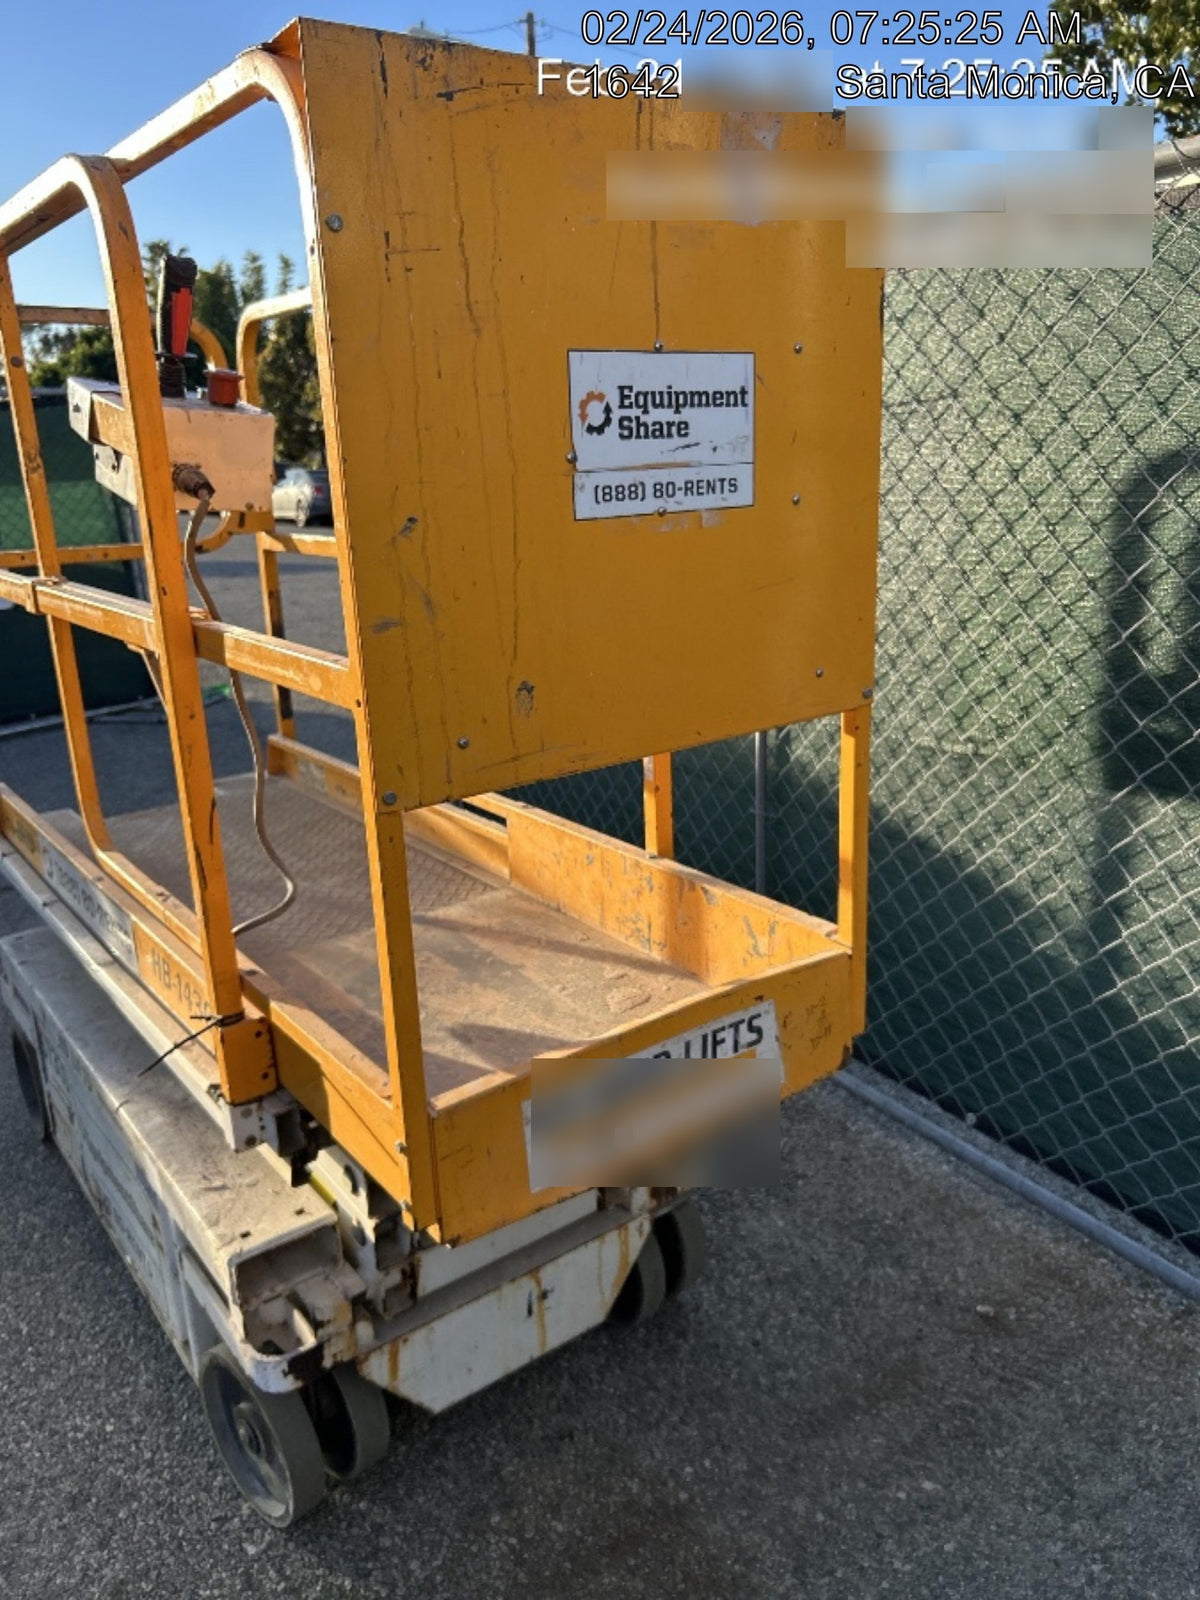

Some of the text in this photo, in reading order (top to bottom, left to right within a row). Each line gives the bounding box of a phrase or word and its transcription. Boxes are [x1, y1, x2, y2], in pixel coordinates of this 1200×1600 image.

[617, 385, 748, 414] Equipment
[618, 416, 689, 440] Share
[594, 477, 738, 505] (888) 80-RENTS
